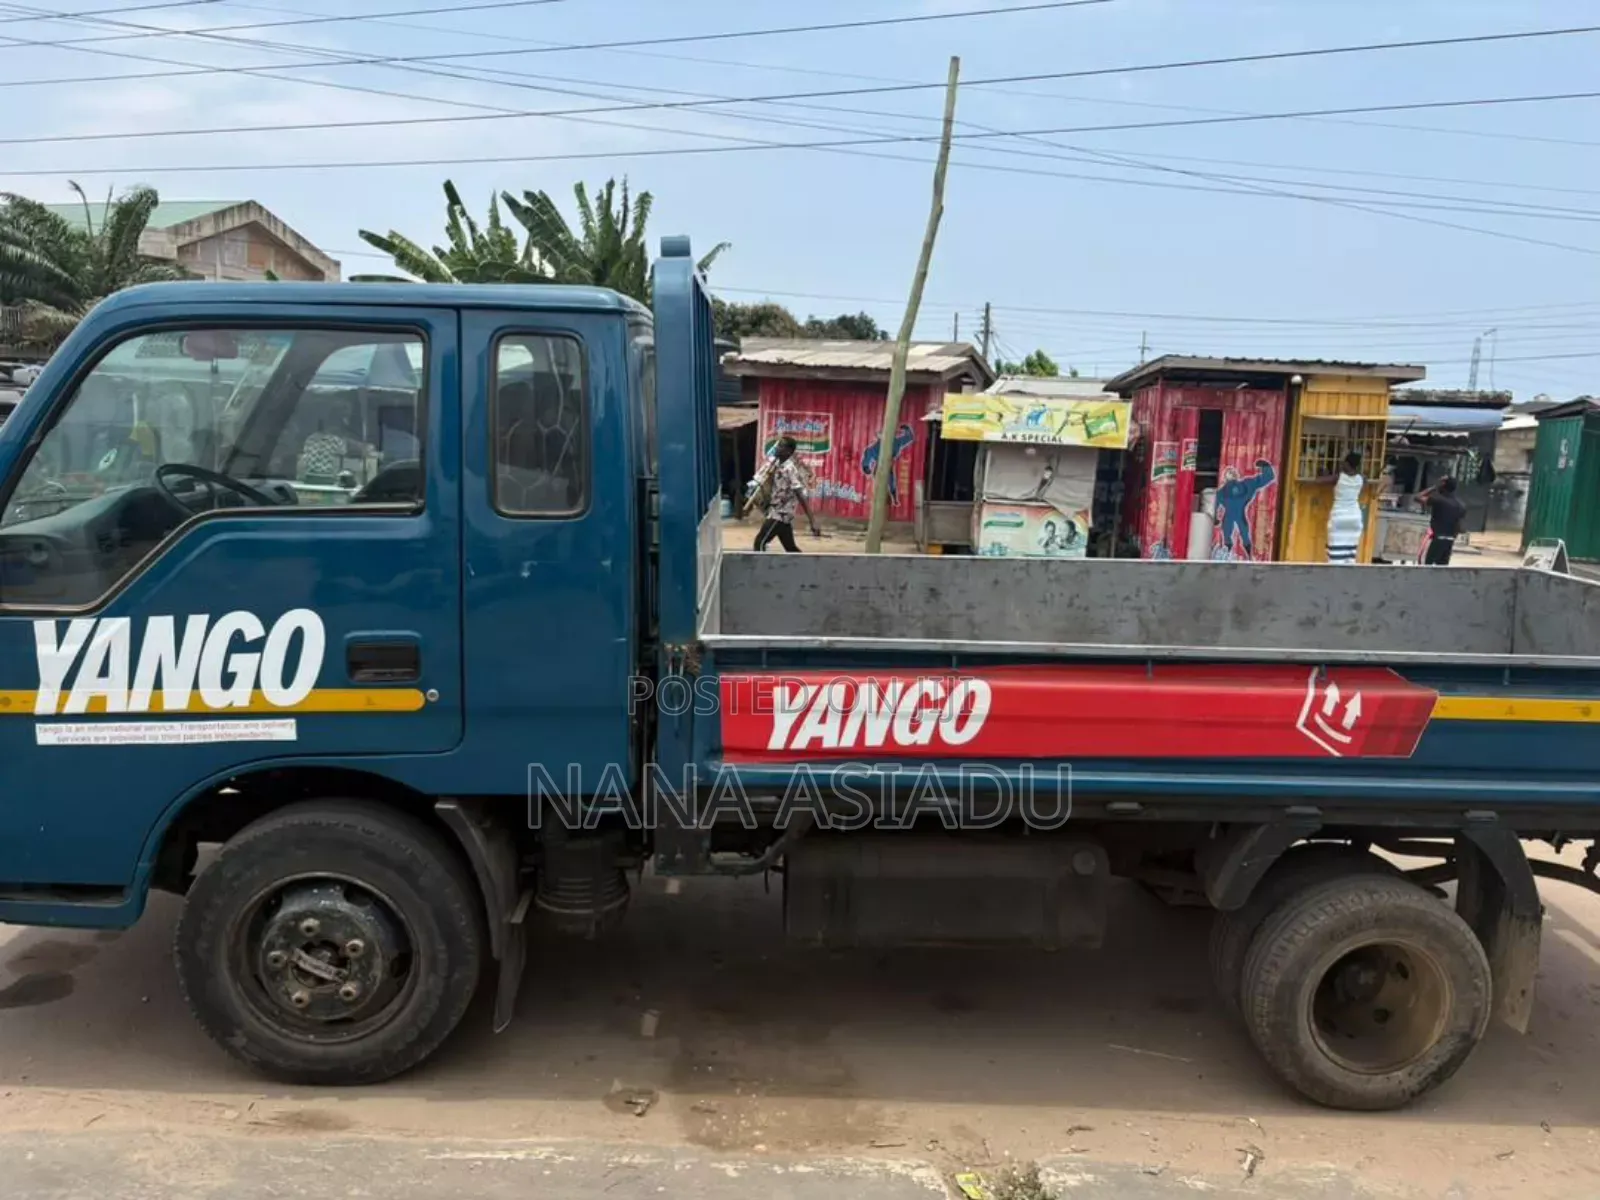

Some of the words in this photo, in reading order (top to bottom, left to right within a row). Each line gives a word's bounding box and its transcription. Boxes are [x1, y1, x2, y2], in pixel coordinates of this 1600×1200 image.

[1021, 433, 1062, 443] SPECIAL
[33, 608, 326, 715] YANGO
[767, 679, 992, 750] YANGO
